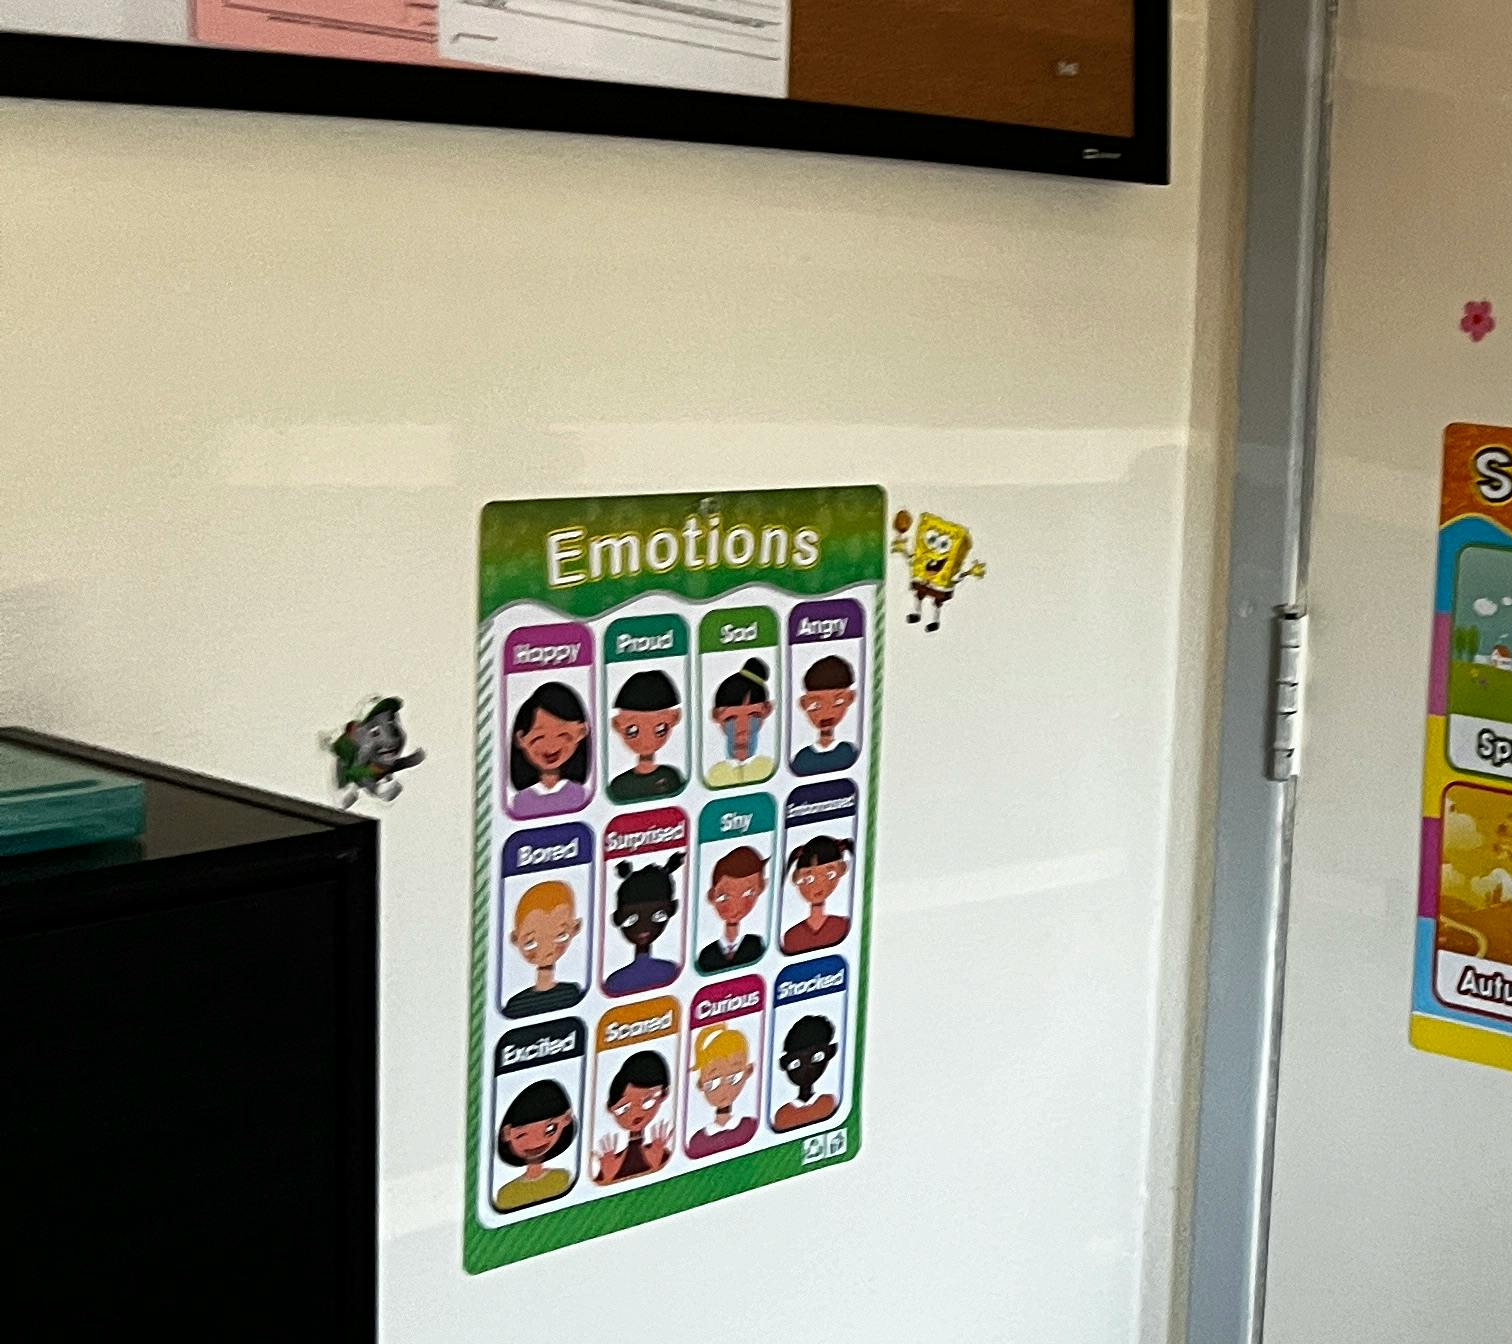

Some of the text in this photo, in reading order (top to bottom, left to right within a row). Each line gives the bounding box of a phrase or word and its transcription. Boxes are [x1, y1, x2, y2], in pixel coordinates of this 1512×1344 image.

[547, 513, 821, 589] Emotions
[616, 628, 676, 655] Proud
[719, 617, 758, 644] Sad
[796, 615, 849, 639] Angry
[512, 641, 582, 666] Happy
[605, 820, 685, 852] Surprised
[719, 810, 753, 834] Shy
[516, 836, 579, 868] Bored
[776, 968, 845, 1000] Shocked
[694, 991, 760, 1021] Curious
[604, 1009, 674, 1044] Scared
[500, 1030, 577, 1067] Excited
